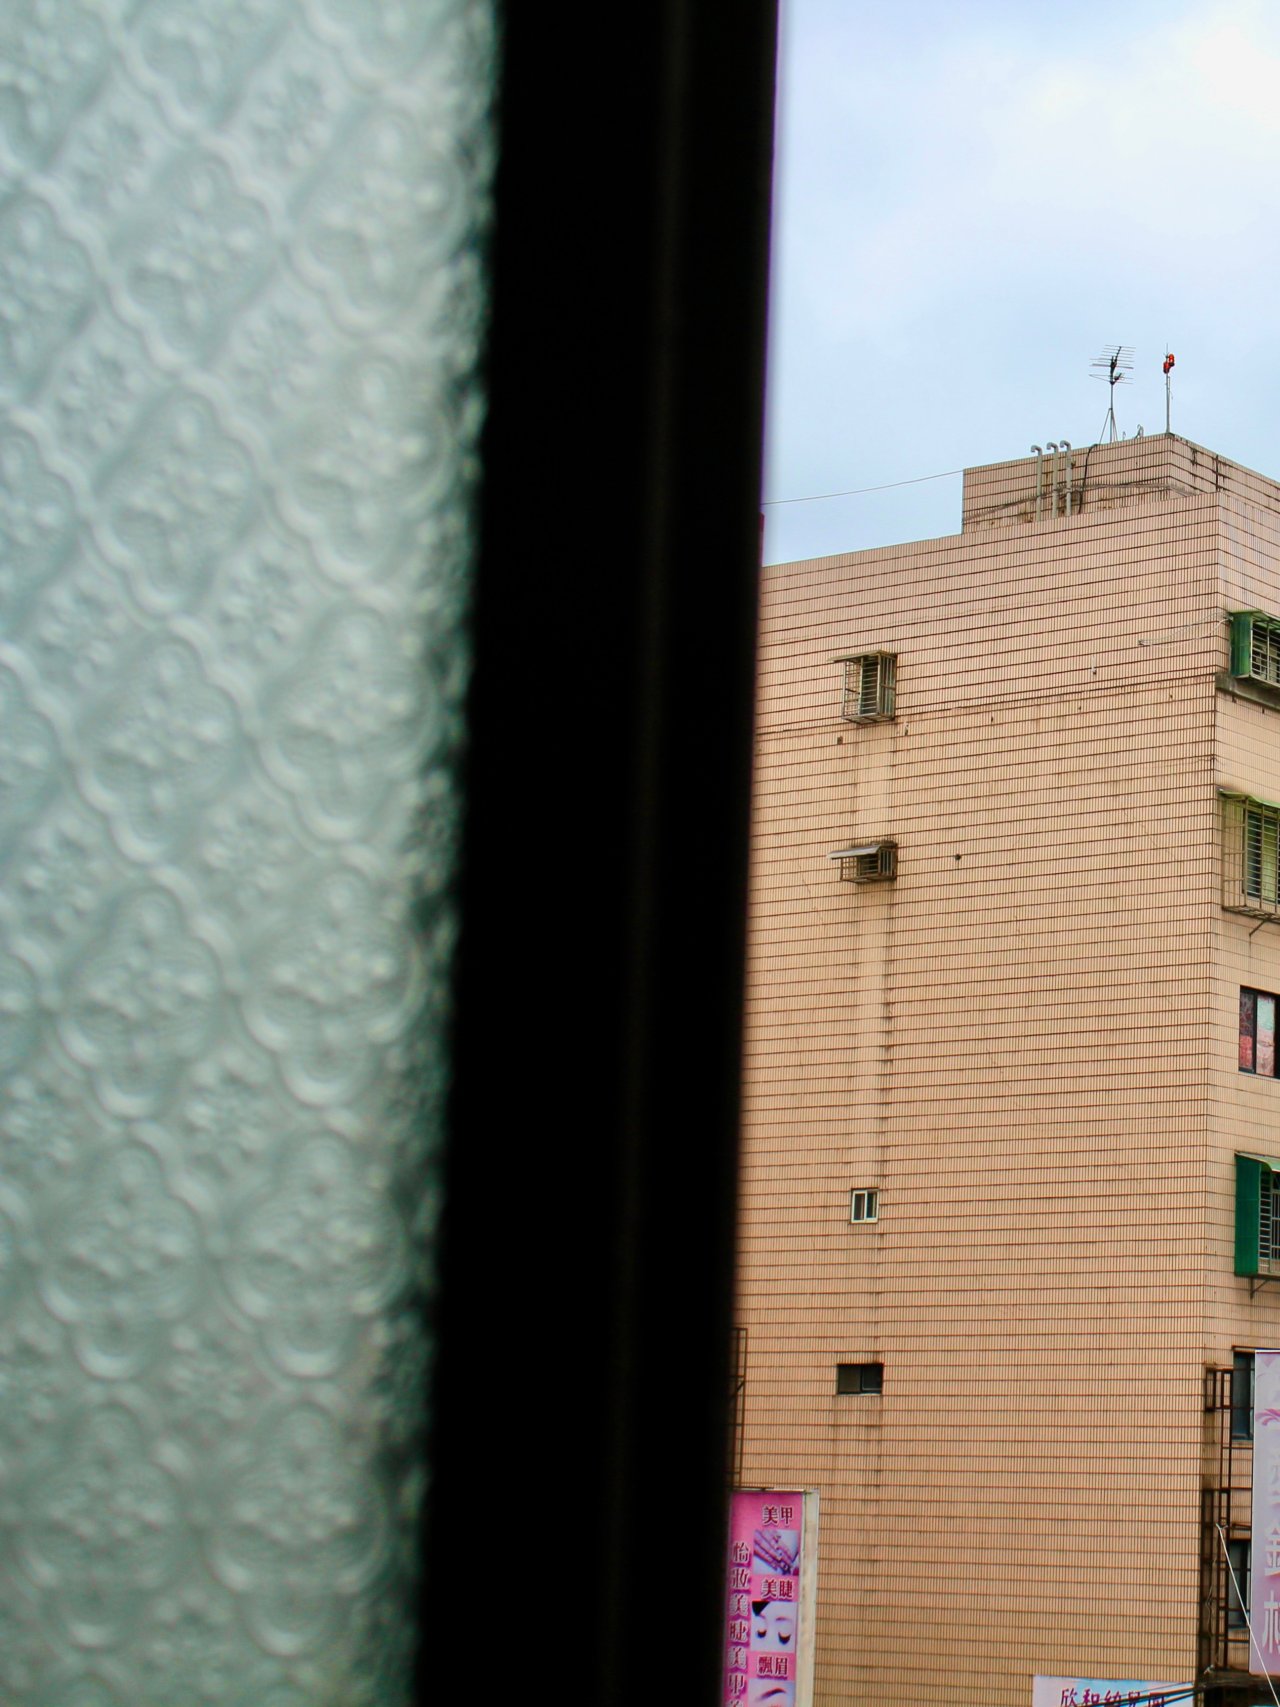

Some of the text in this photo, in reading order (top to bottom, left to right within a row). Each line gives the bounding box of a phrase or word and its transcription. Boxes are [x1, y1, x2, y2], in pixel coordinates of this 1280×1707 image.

[762, 1505, 794, 1525] 美甲
[761, 1579, 793, 1599] 美睫
[757, 1655, 788, 1677] 飄眉
